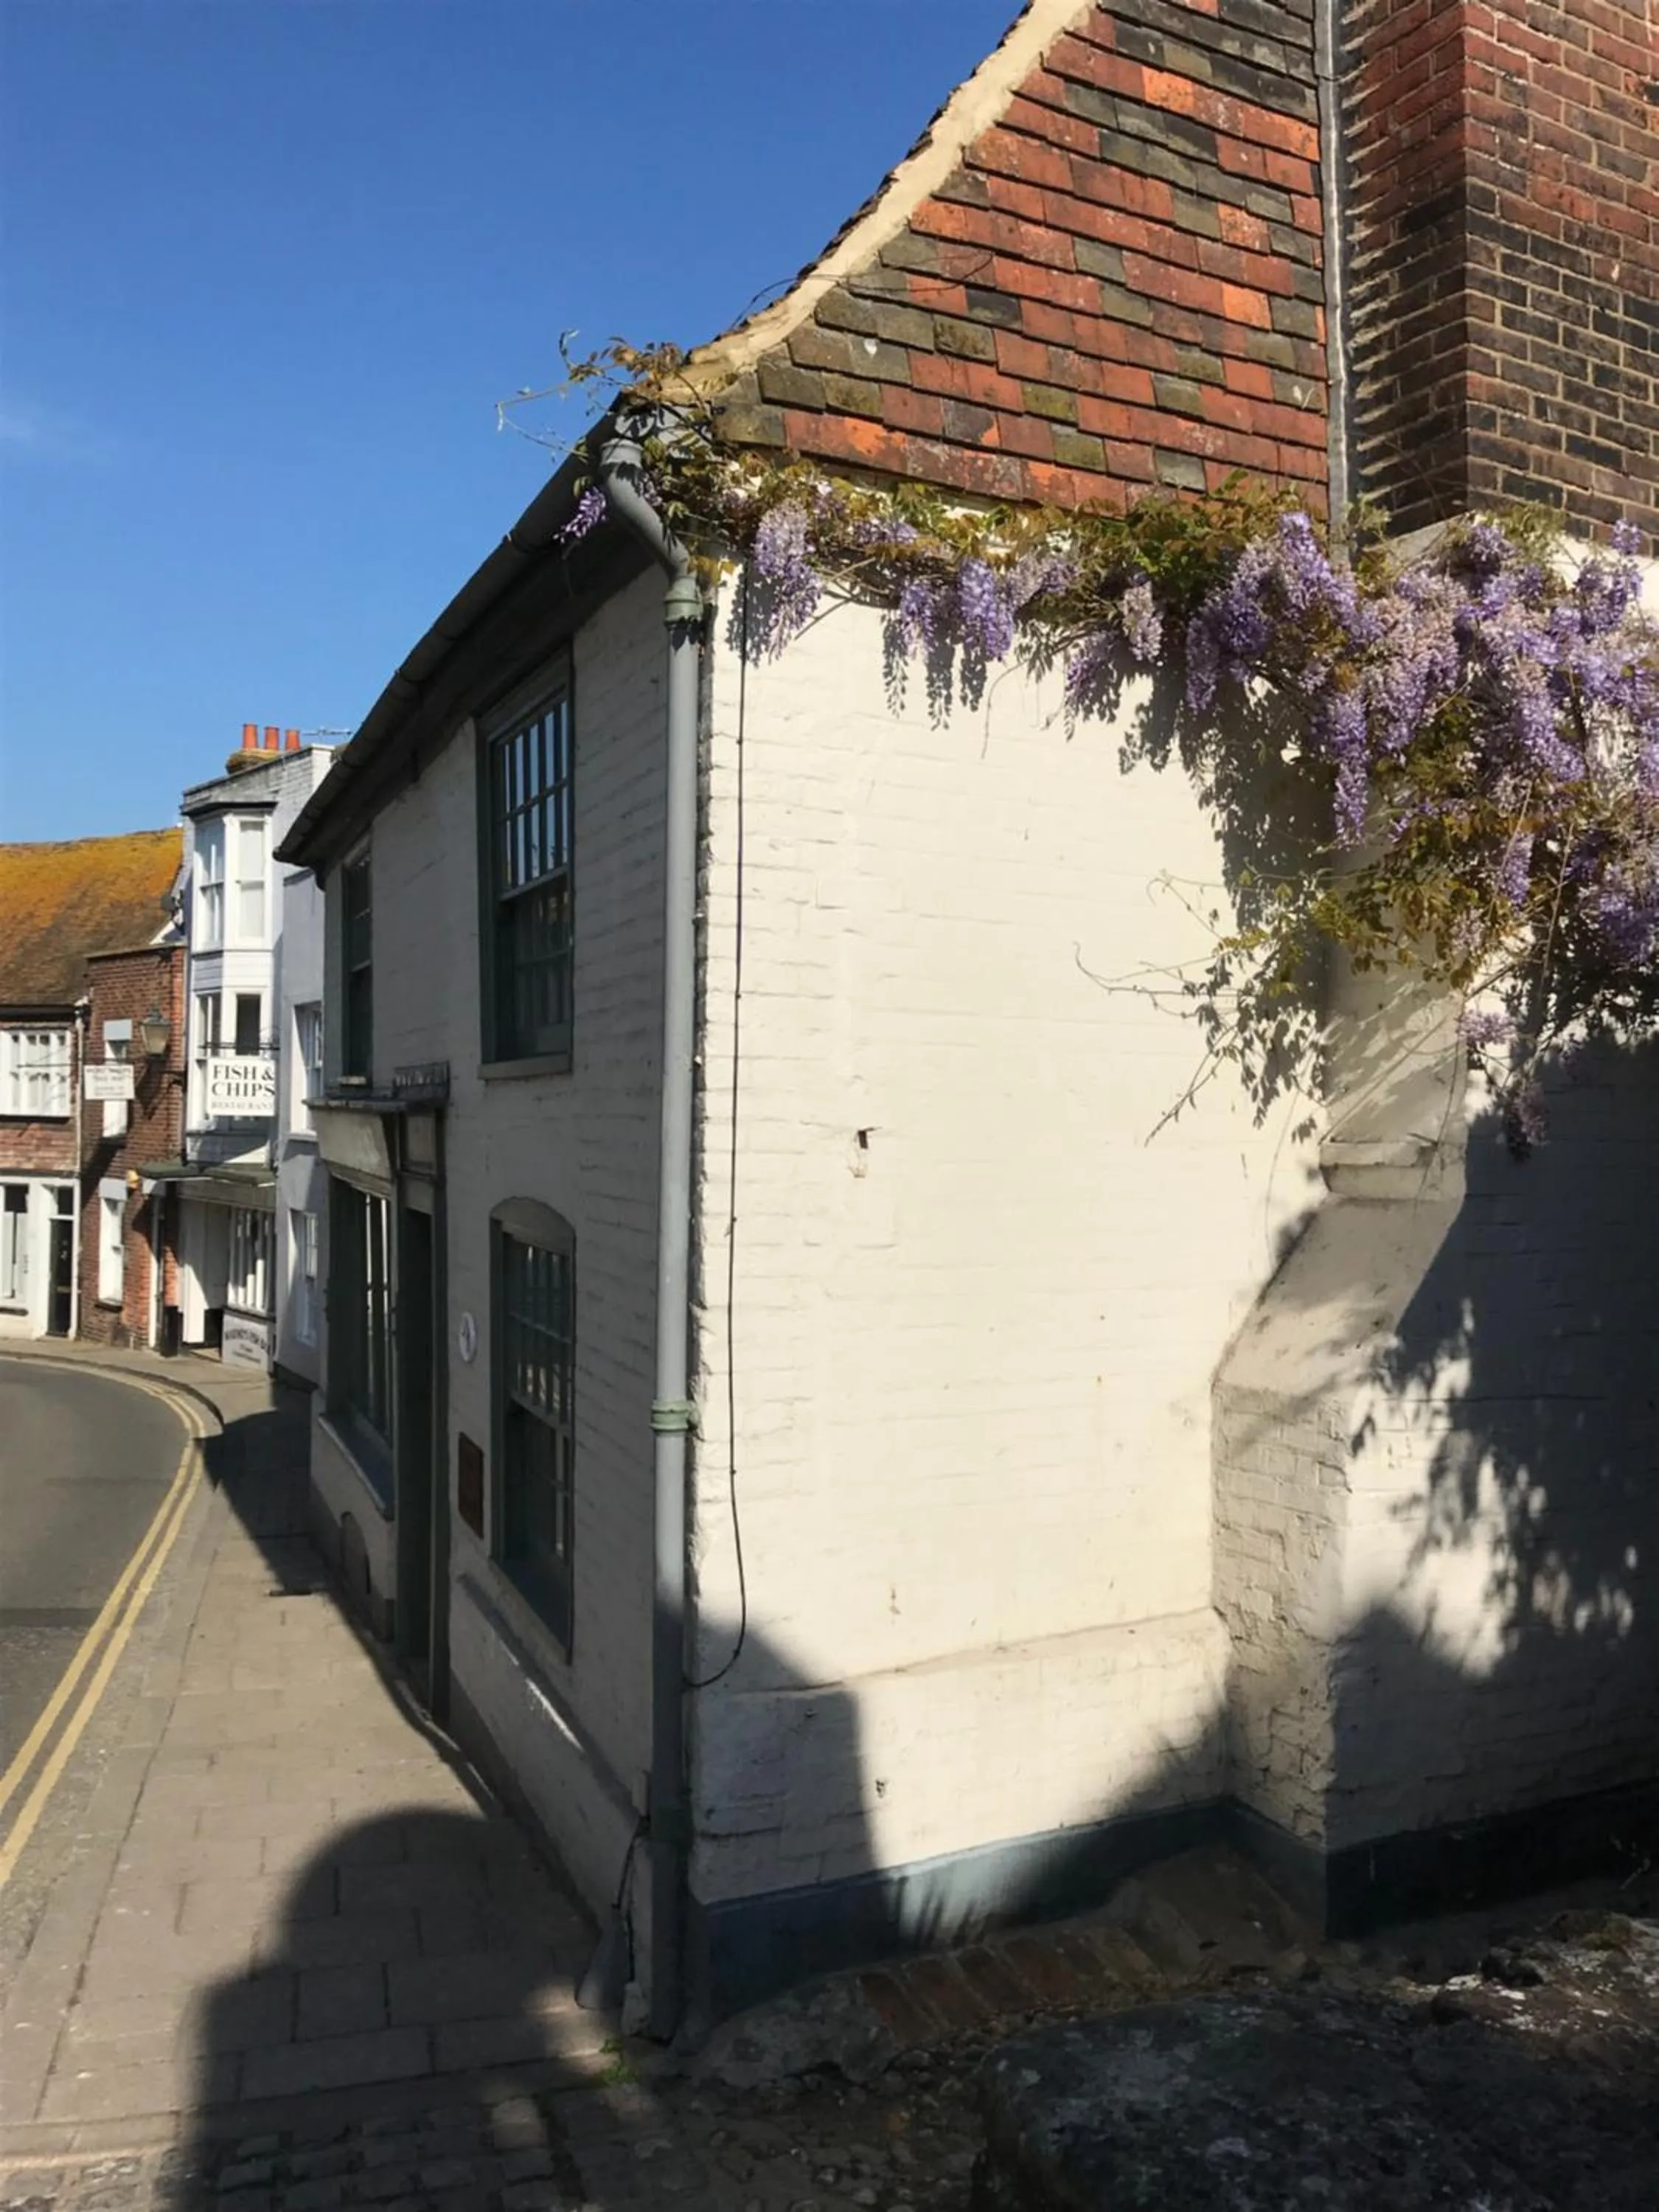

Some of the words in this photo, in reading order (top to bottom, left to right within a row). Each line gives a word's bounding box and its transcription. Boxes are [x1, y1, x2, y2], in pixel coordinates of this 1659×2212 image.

[213, 1065, 257, 1080] FISH
[260, 1066, 275, 1081] &
[211, 1082, 276, 1097] CHIPS
